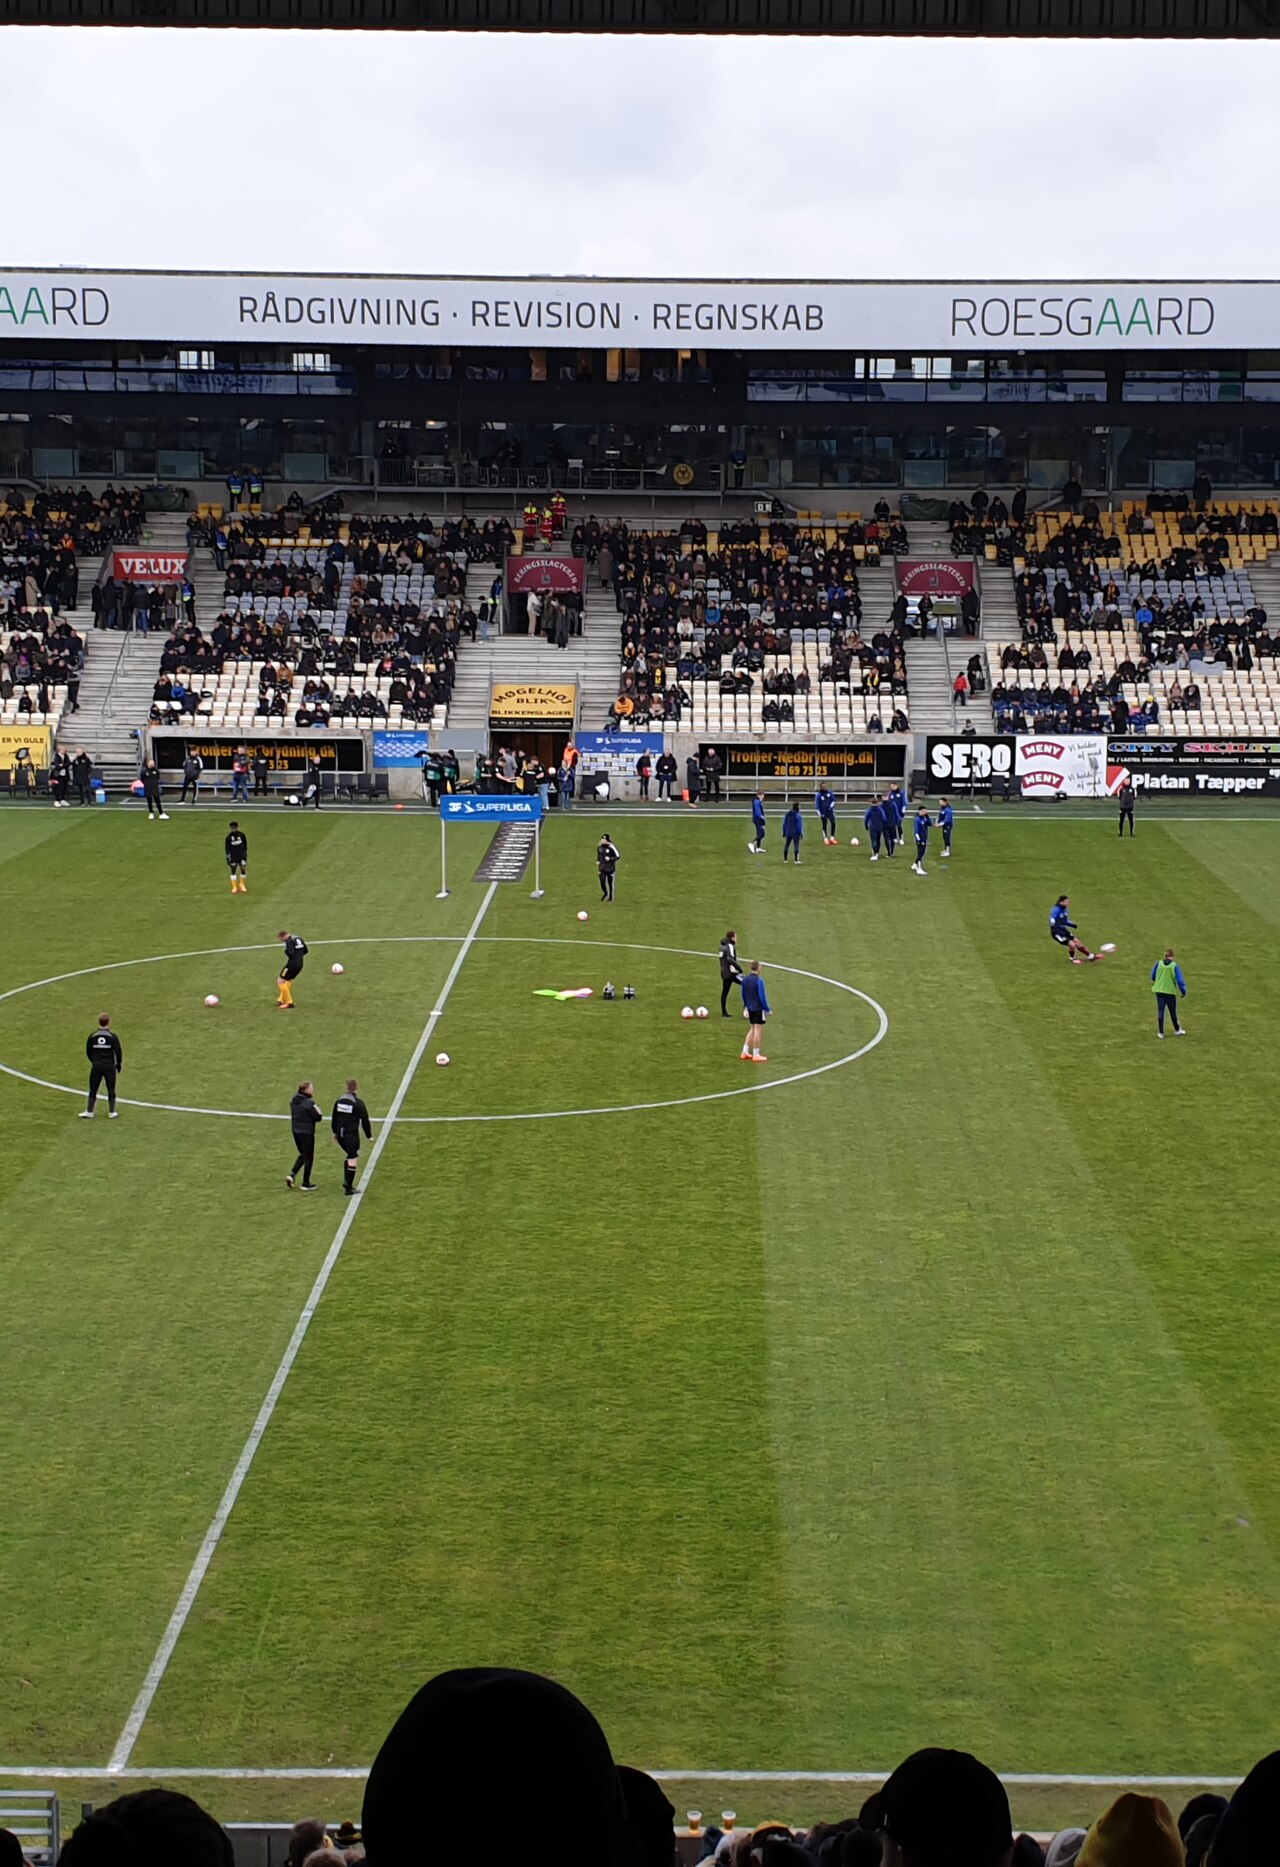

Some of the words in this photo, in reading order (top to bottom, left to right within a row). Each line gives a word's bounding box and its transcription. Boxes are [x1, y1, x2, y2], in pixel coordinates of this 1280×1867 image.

[239, 291, 440, 327] RÅDGIVNING
[471, 300, 621, 330] REVISION
[654, 303, 824, 331] REGNSKAB
[951, 298, 1214, 336] ROESGAARD
[118, 558, 187, 575] VELUX
[1025, 743, 1062, 755] MENY
[1024, 773, 1061, 785] MENY
[1131, 774, 1189, 789] Platan
[1195, 775, 1265, 792] Tæpper
[476, 803, 532, 812] SUPERLIGA
